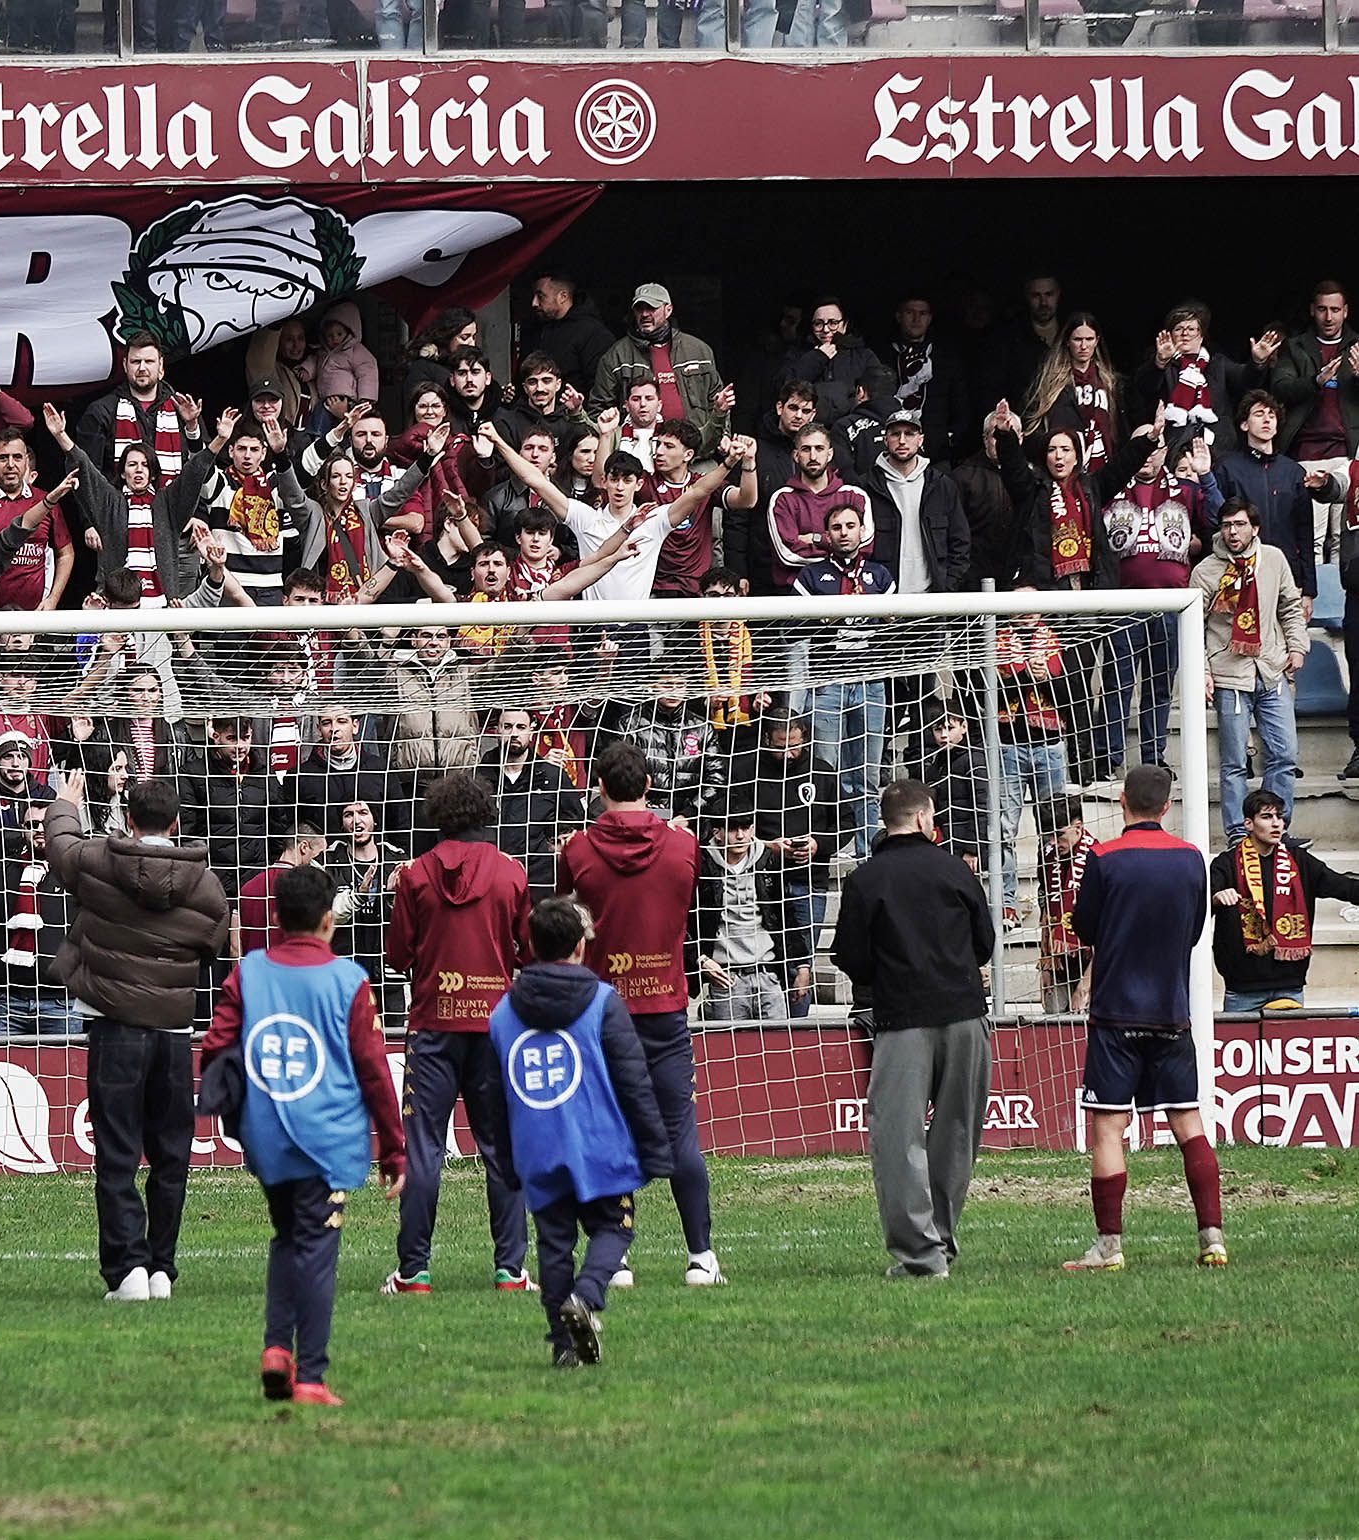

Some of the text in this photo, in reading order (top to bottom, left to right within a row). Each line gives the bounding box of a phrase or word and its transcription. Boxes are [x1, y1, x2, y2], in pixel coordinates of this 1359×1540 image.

[238, 74, 552, 169] Galicia
[866, 71, 1204, 164] Estrella
[628, 976, 659, 987] XUNTA
[629, 985, 675, 997] DE GALICIA
[455, 1000, 488, 1009] XUNTA
[455, 1009, 468, 1018] DE
